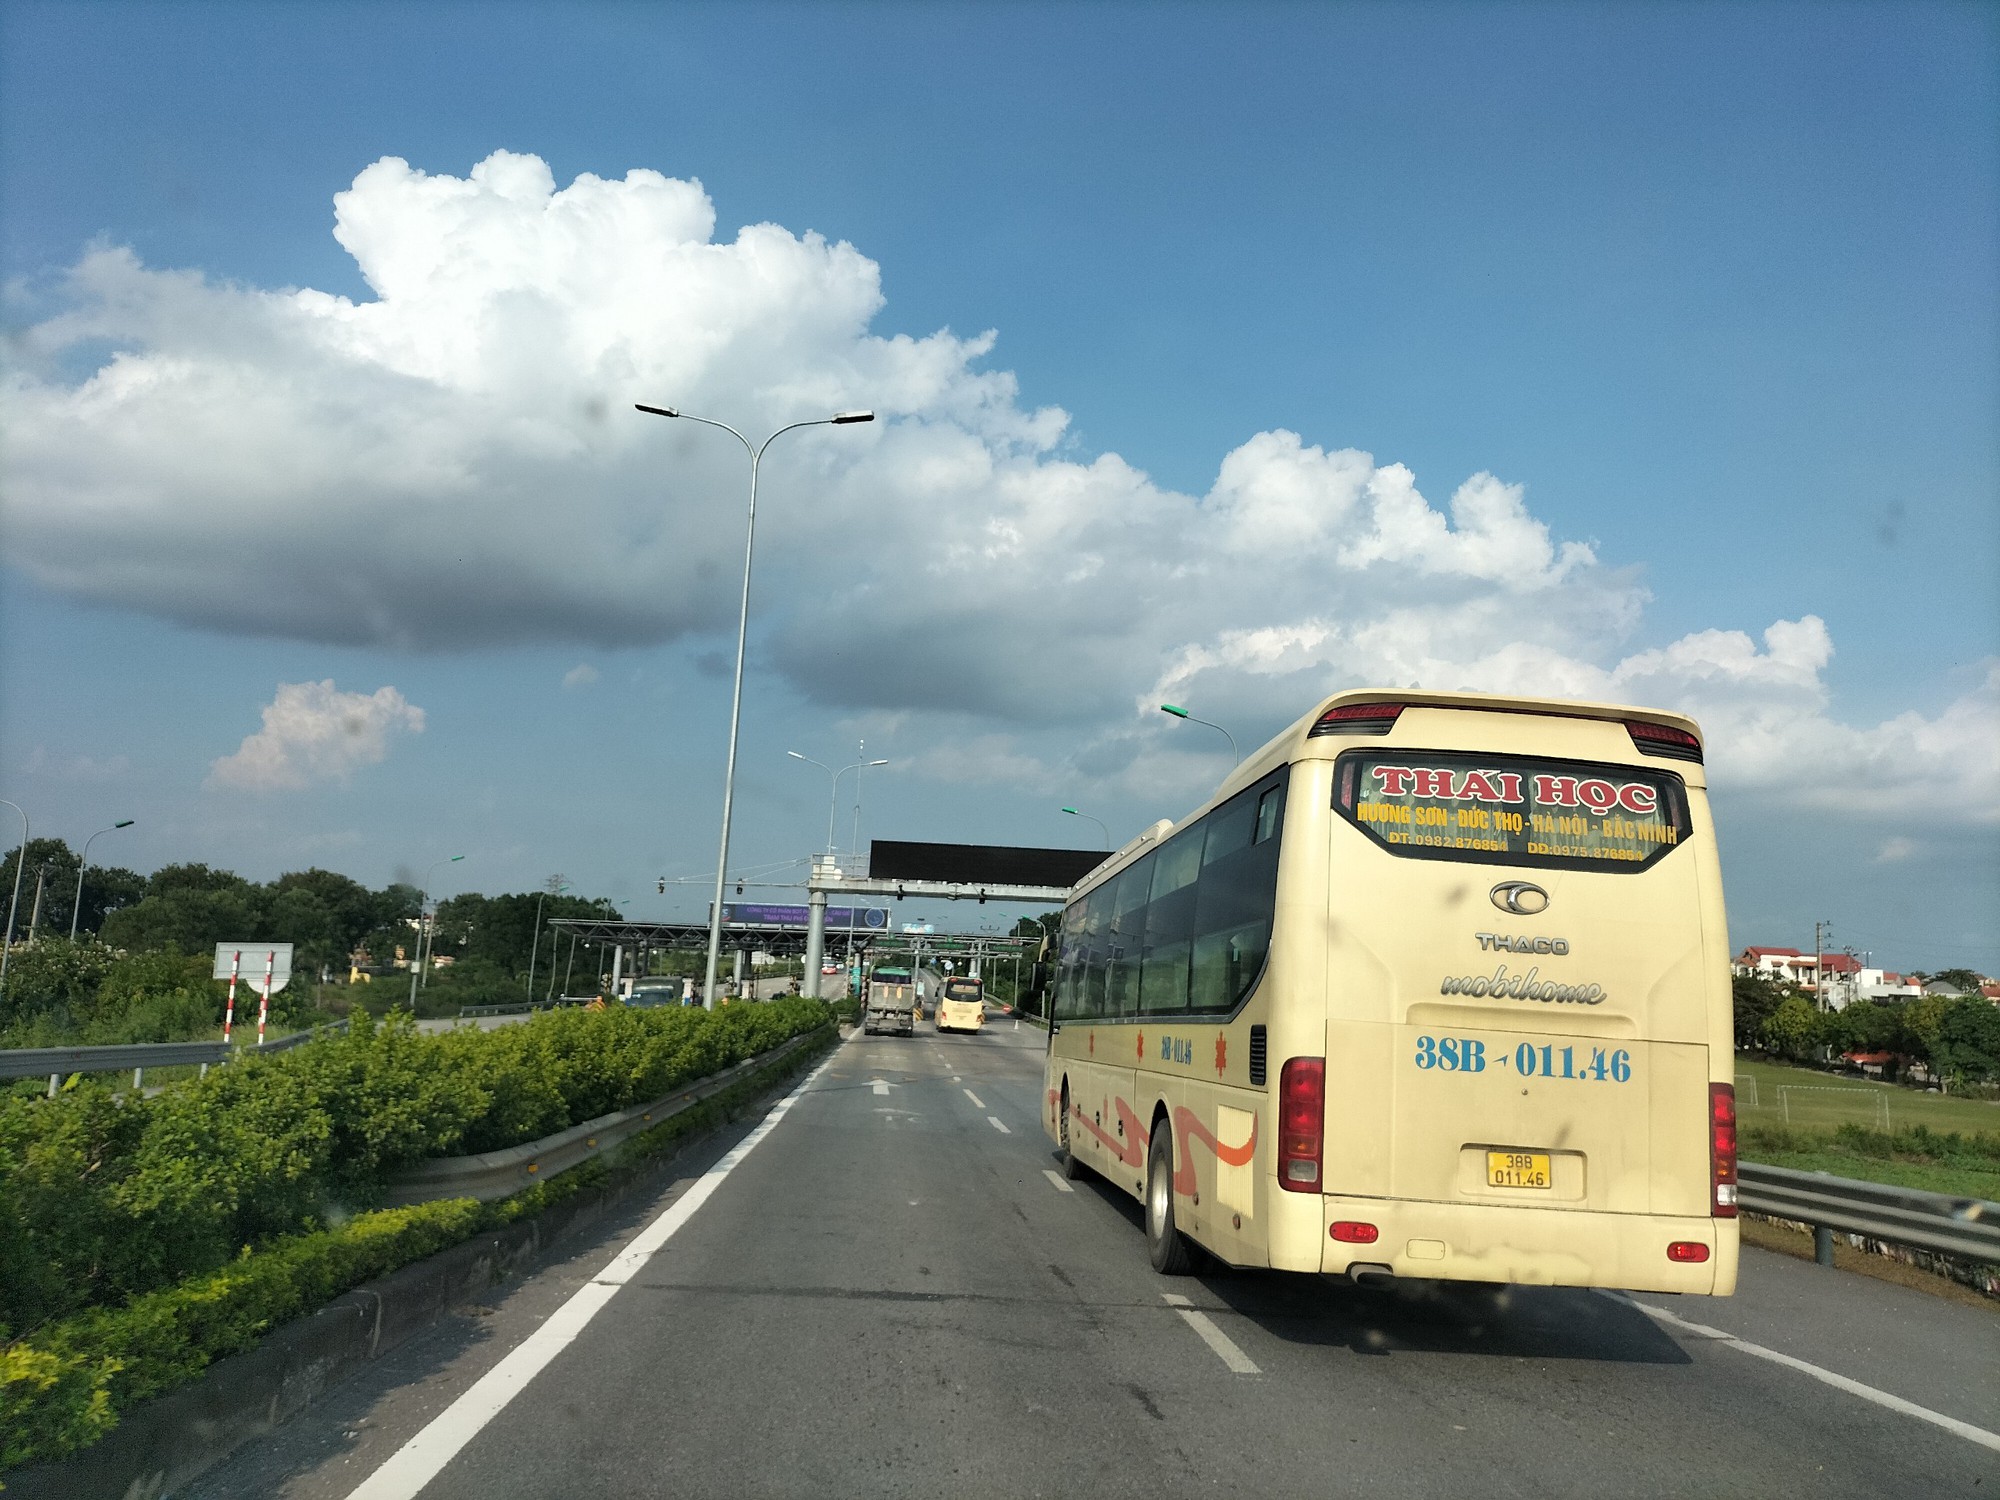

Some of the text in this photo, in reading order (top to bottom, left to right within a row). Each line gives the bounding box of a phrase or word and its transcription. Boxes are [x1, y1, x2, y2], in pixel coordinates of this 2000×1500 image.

[1372, 765, 1657, 815] THÁI HỌC
[1357, 801, 1411, 824] HƯƠNG
[1415, 805, 1448, 827] SƠN
[1457, 803, 1489, 829] ĐỨC
[1493, 811, 1523, 836] THỌ
[1533, 811, 1555, 833] HÀ
[1559, 813, 1588, 840] NỘI
[1602, 814, 1635, 839] BẮC
[1637, 823, 1677, 845] NINH
[1415, 835, 1508, 852] 0982.876854
[1475, 932, 1570, 956] THACO
[1440, 964, 1607, 1006] mobihome
[1415, 1035, 1486, 1073] 38B
[1515, 1042, 1631, 1083] 011.46
[1495, 1170, 1544, 1186] 011.46
[1506, 1155, 1532, 1169] 38B
